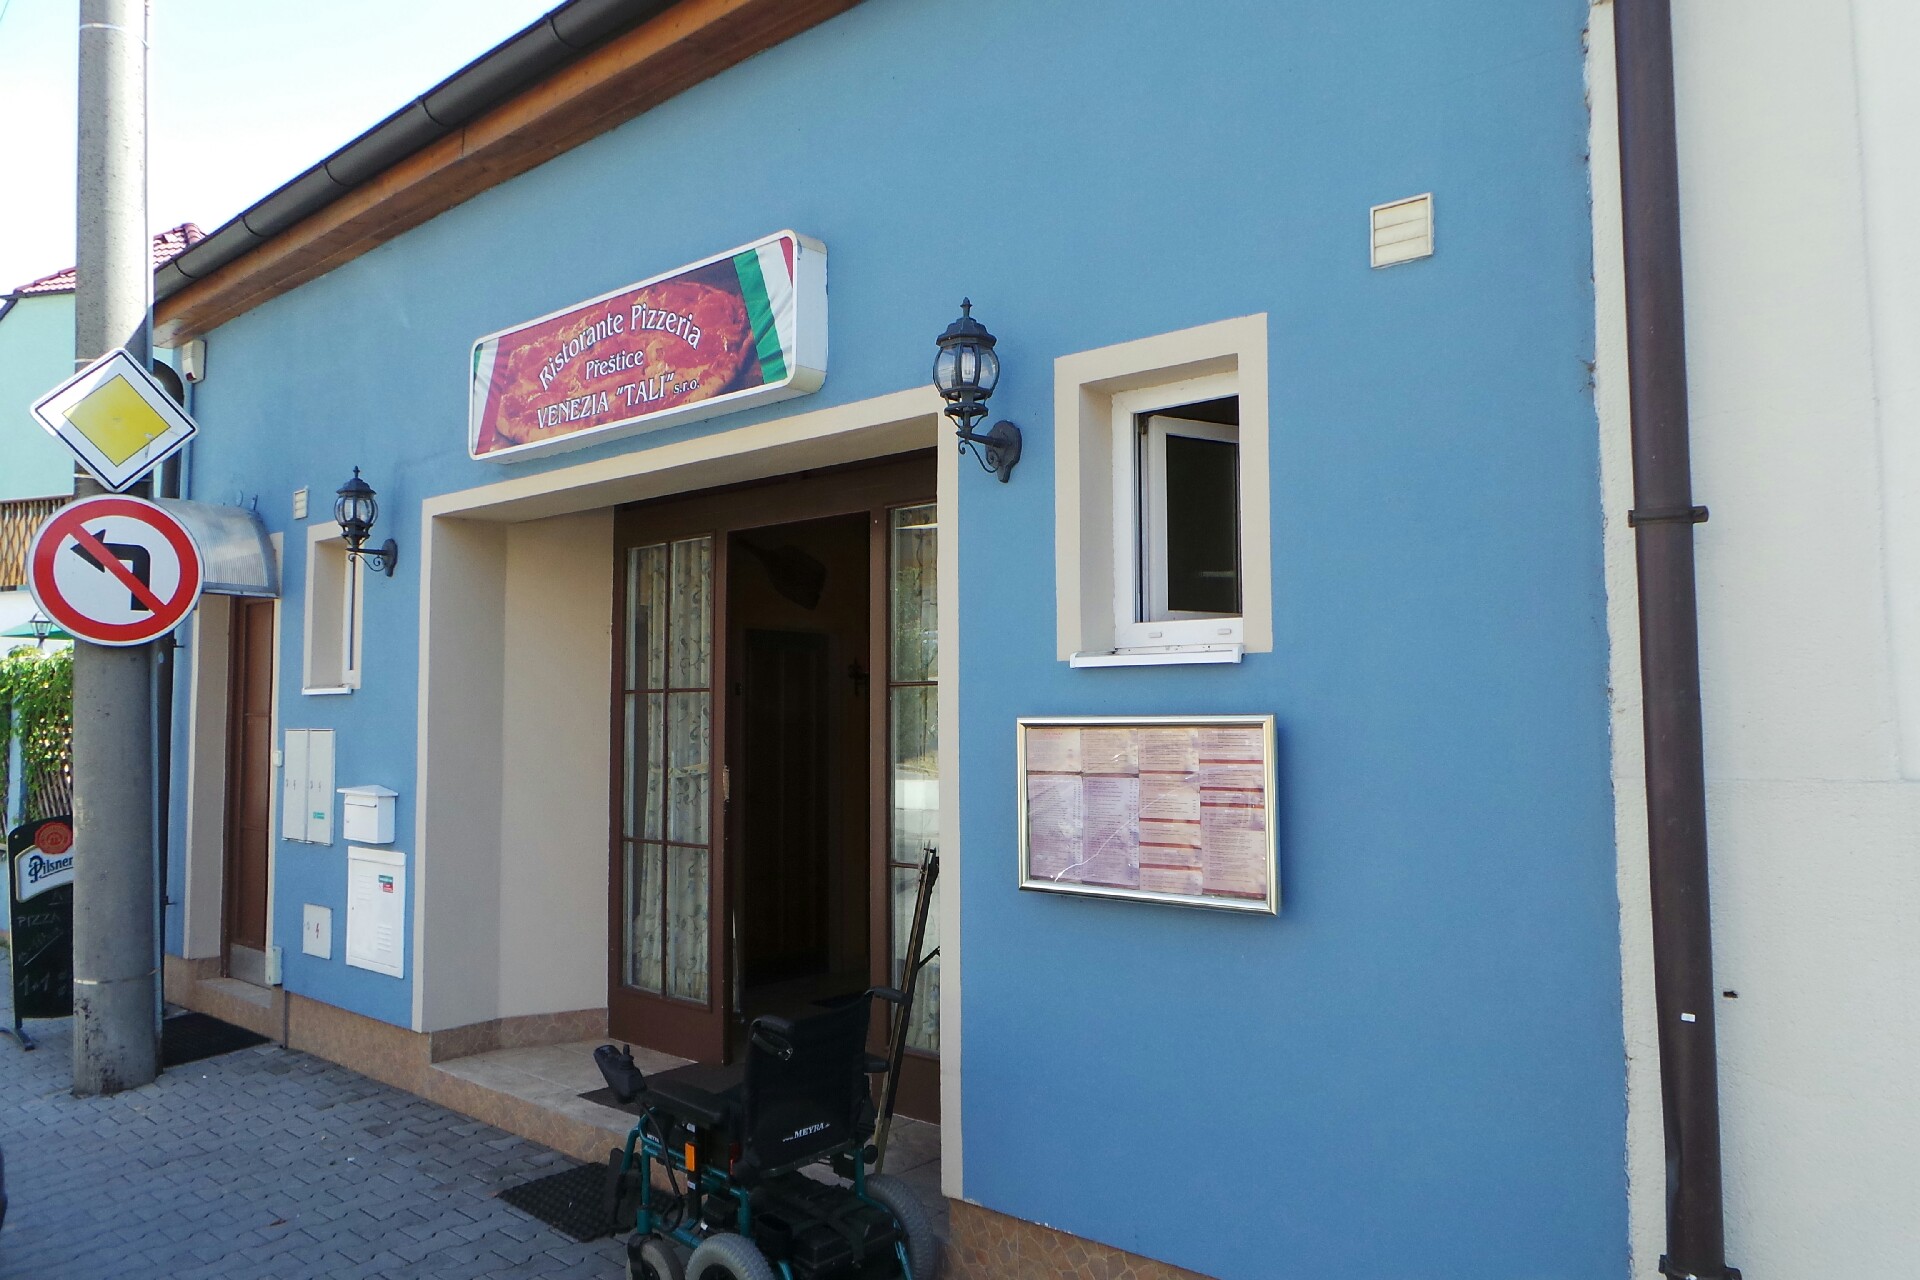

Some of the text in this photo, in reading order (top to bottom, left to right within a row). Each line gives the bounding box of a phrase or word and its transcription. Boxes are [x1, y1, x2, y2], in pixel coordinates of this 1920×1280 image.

[538, 303, 702, 391] Ristorante Pizzeria
[585, 350, 644, 381] Přeštice
[536, 372, 700, 429] VENEZIA "TALI" s.r.o.
[28, 855, 74, 884] Pilsner
[794, 1122, 824, 1139] MEYRA
